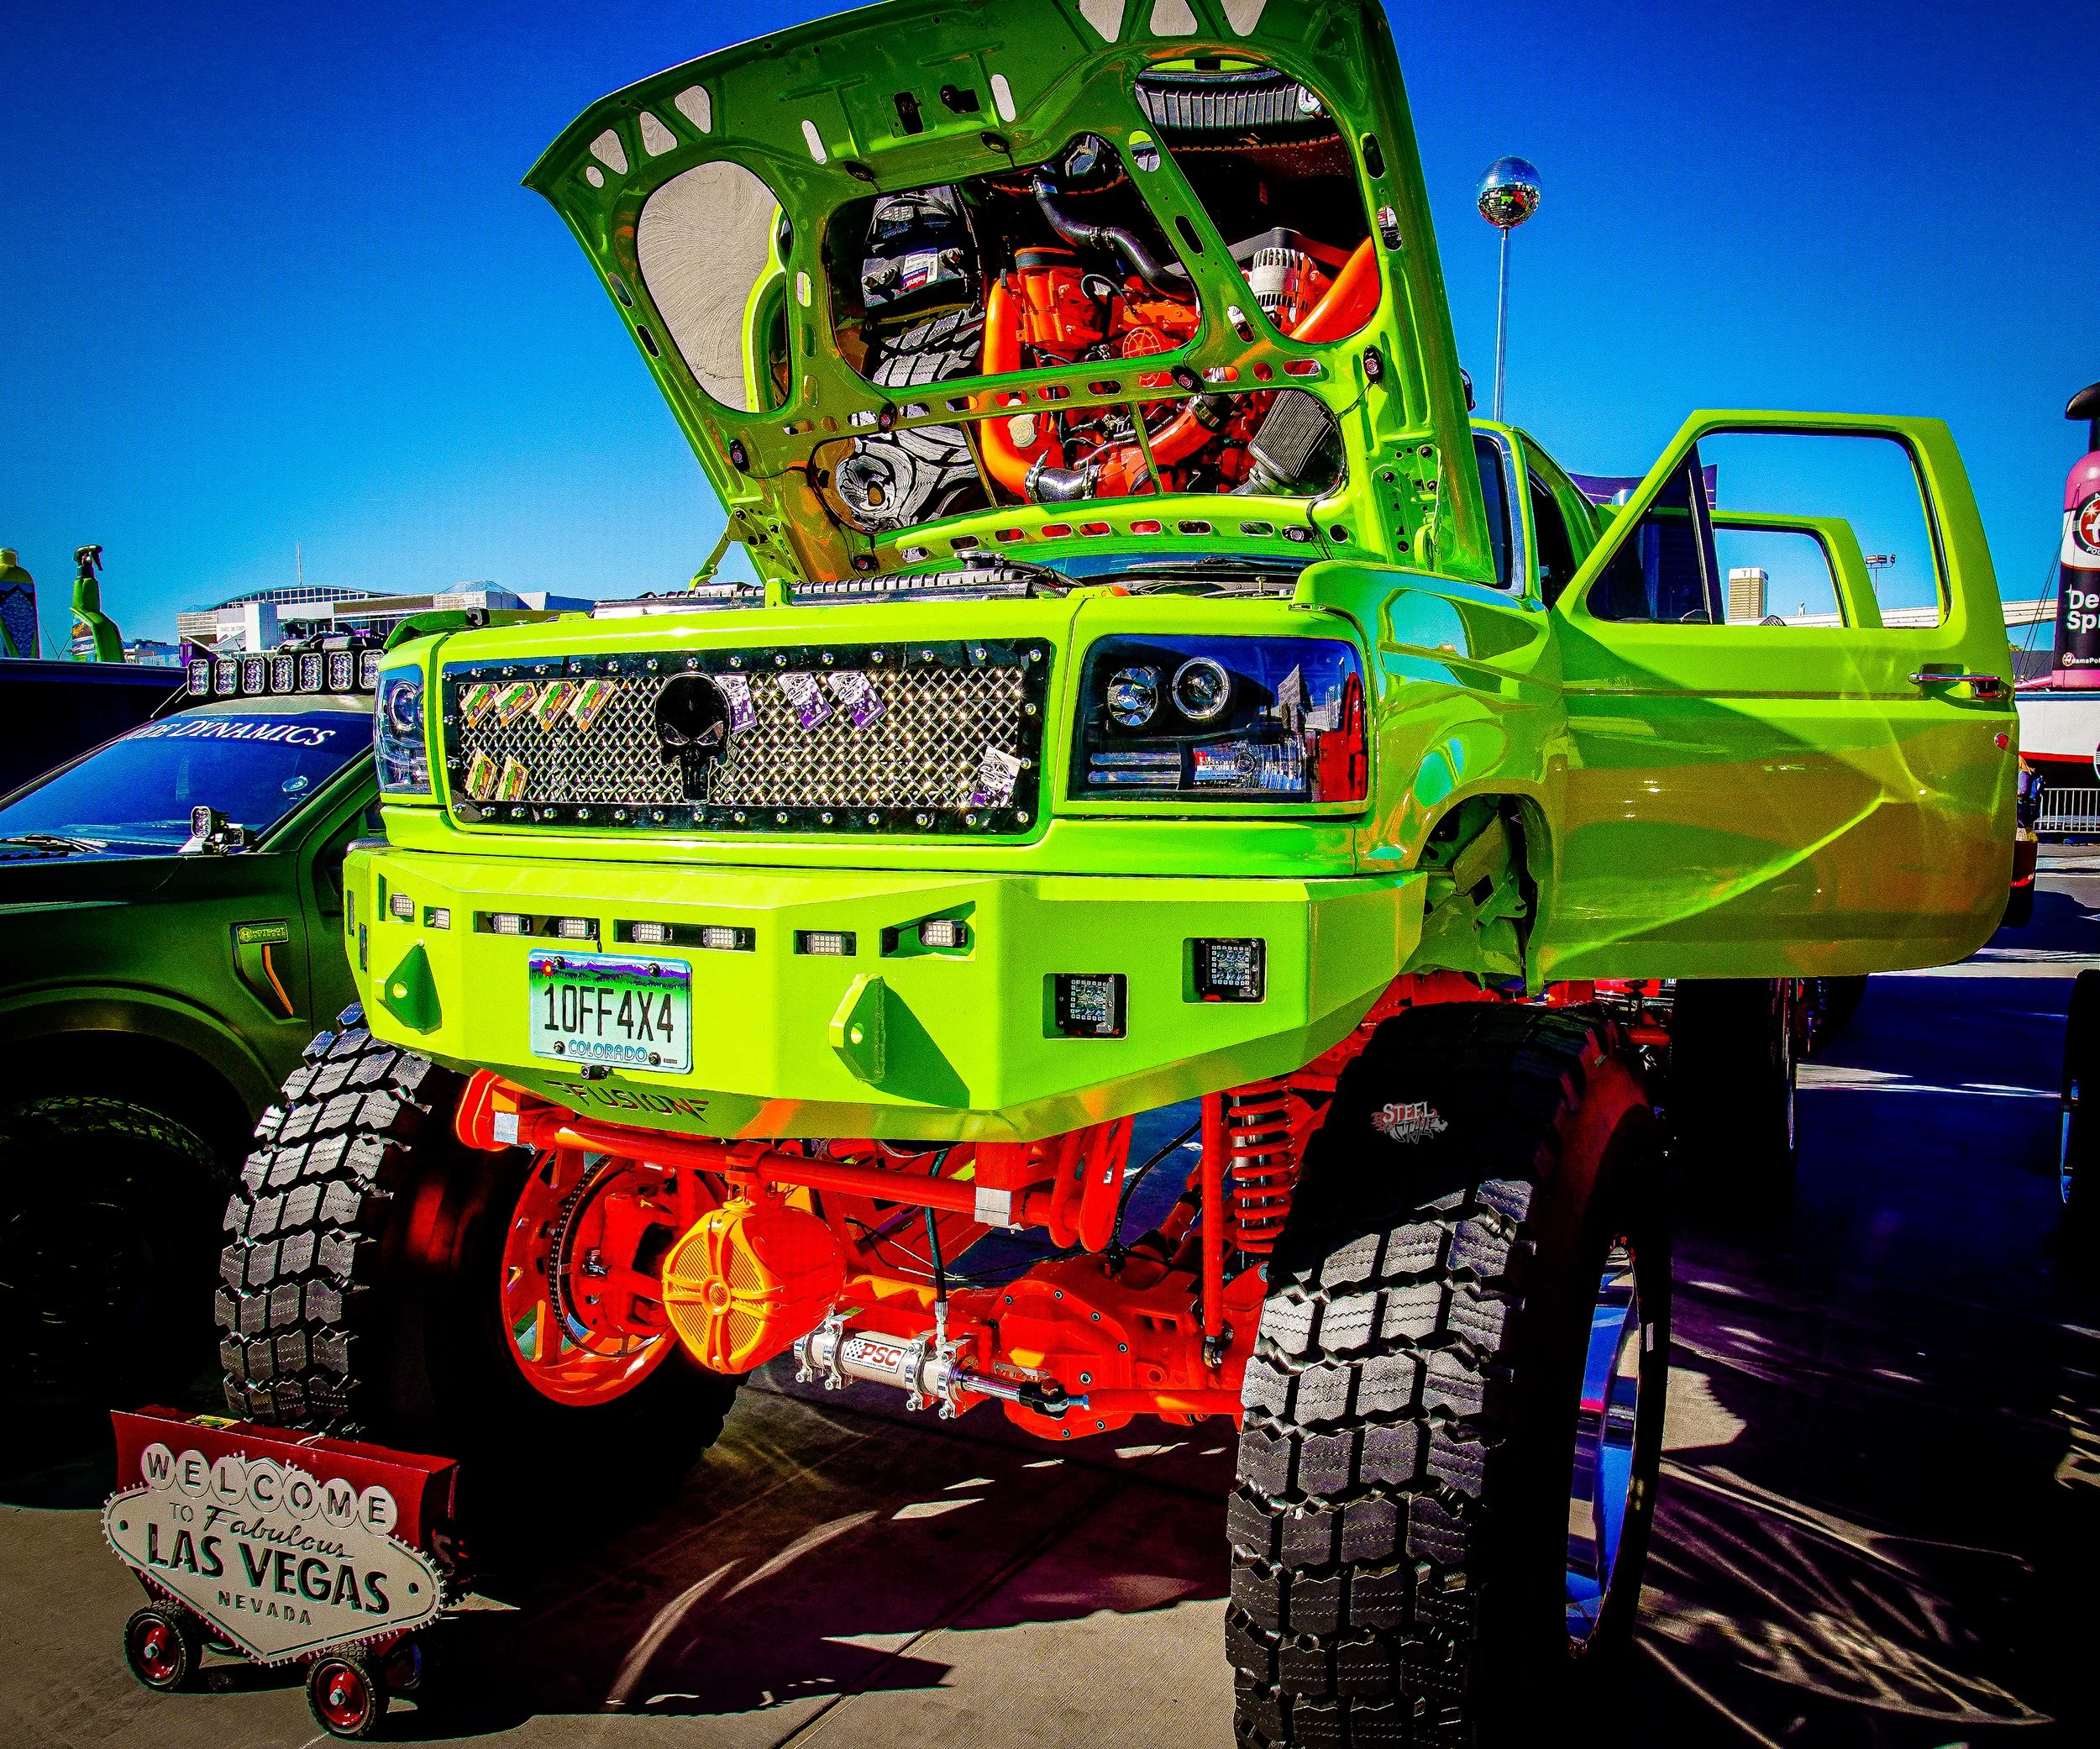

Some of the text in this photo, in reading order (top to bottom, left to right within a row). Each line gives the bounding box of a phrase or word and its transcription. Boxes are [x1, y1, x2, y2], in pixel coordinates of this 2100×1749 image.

[168, 720, 336, 746] DYNAMICS
[568, 1039, 648, 1063] COLORADO
[543, 1079, 710, 1124] FUSION
[1382, 1101, 1436, 1124] STEEL
[858, 1342, 901, 1367] PSC
[145, 1451, 387, 1526] WELCOME
[169, 1502, 356, 1560] TO Fabulous
[148, 1523, 391, 1616] LAS VEGAS
[218, 1589, 312, 1627] NEVADA
